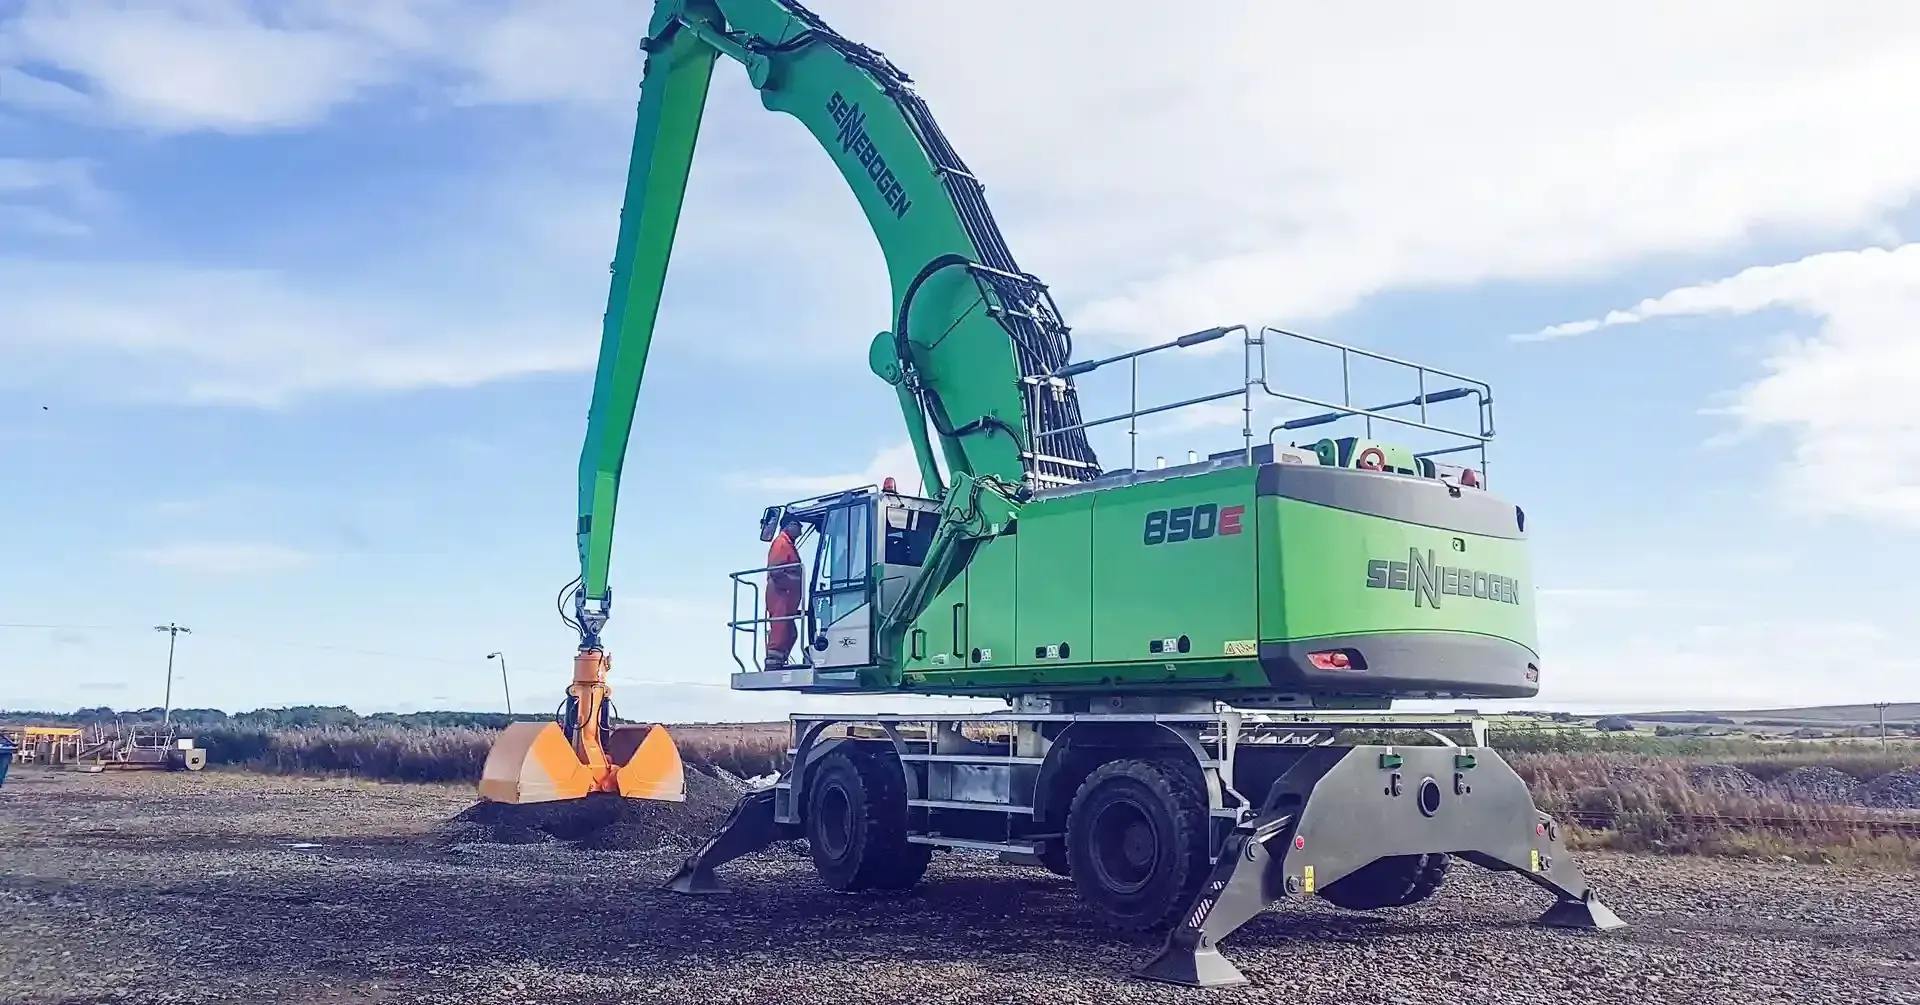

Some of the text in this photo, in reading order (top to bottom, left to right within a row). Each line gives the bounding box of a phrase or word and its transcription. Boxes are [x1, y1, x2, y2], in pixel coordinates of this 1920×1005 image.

[826, 91, 912, 220] SENNEBOGEN
[1144, 503, 1245, 545] 850E
[1366, 547, 1519, 609] SENNEBOGEN
